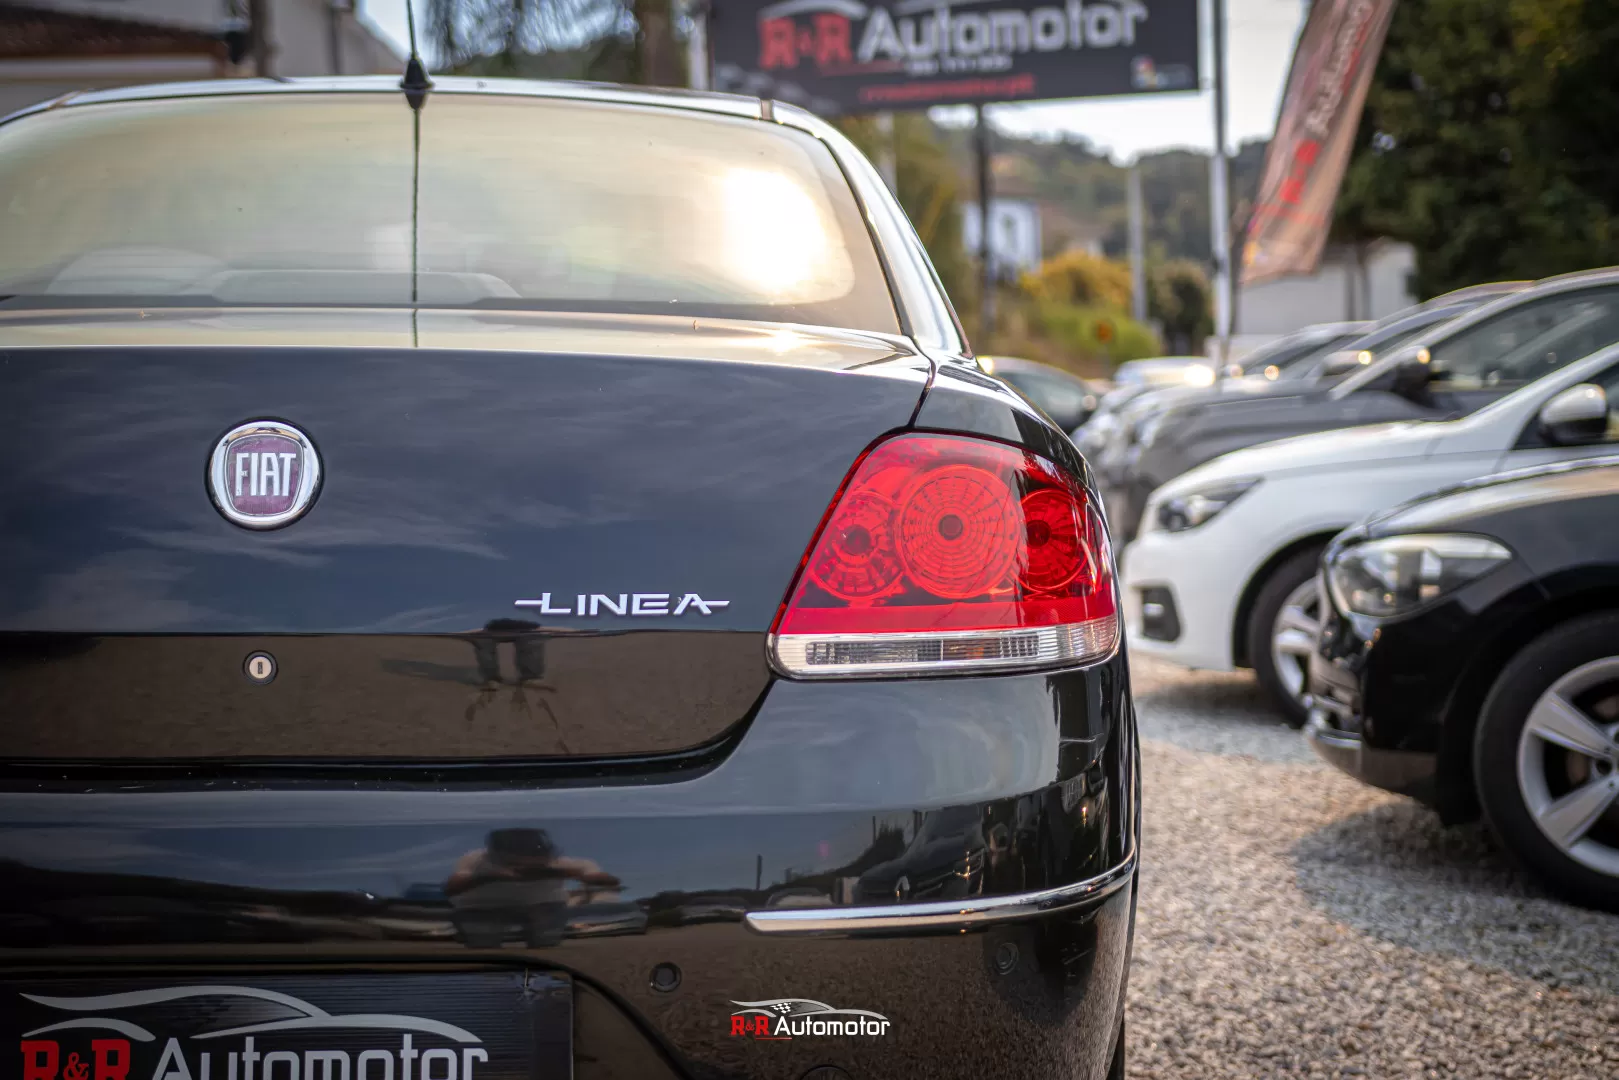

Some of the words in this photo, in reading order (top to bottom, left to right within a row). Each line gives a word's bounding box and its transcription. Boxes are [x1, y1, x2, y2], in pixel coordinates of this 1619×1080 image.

[857, 0, 1148, 64] Automotor
[235, 452, 297, 497] FIAT
[515, 592, 730, 616] LINEA
[152, 1034, 489, 1080] Automotor
